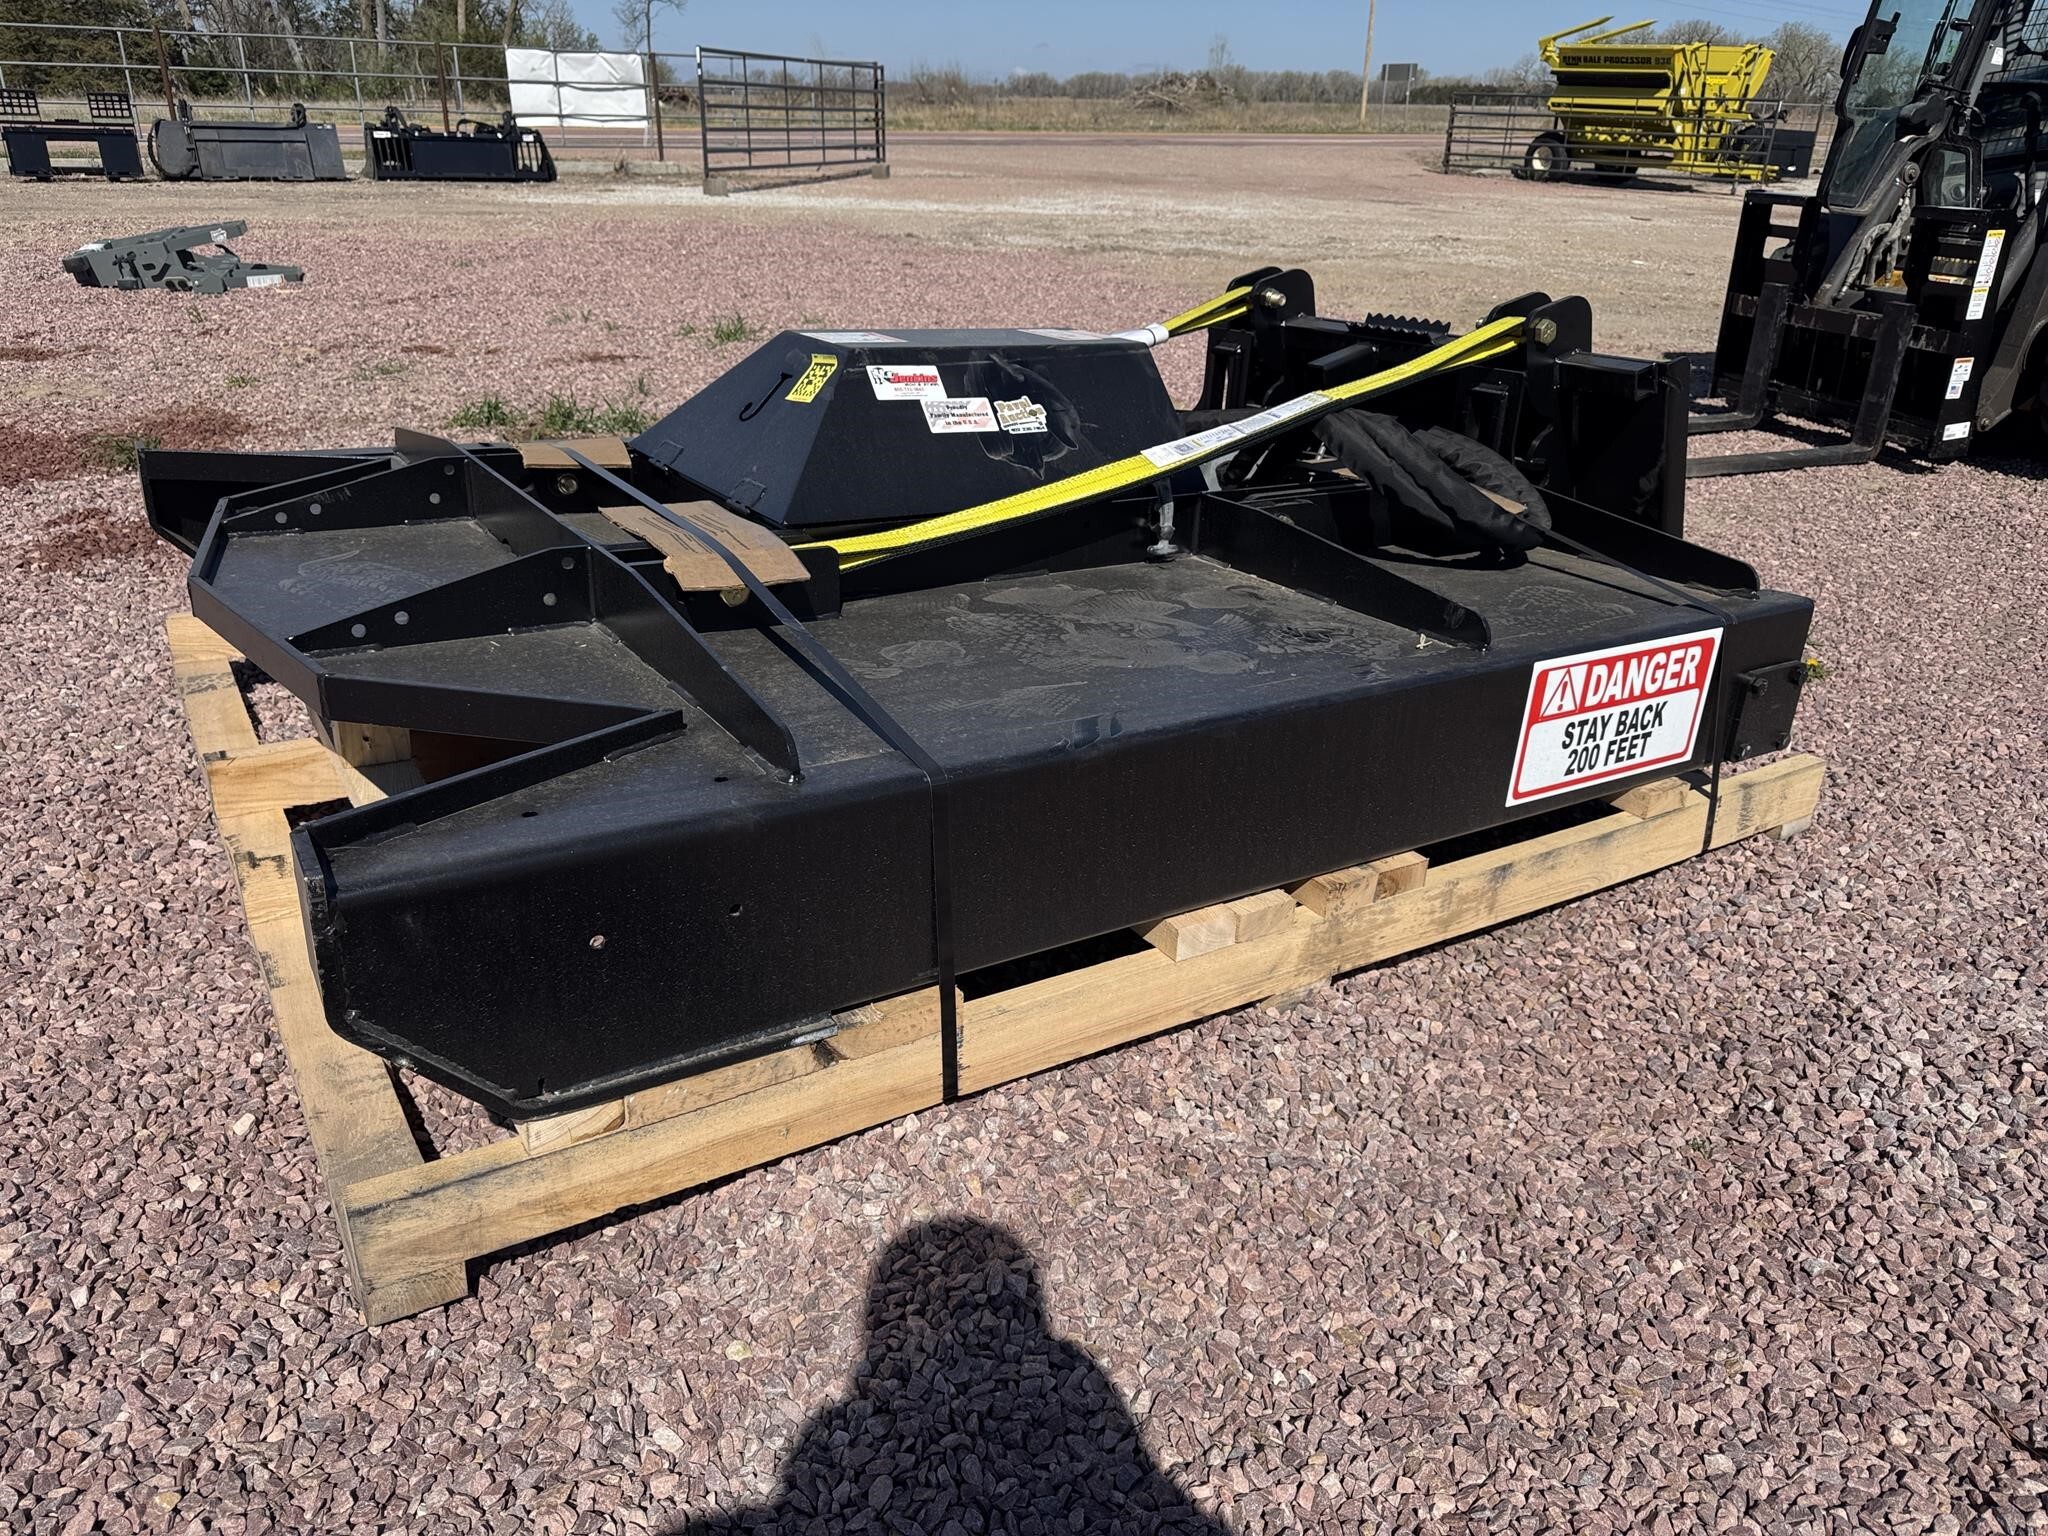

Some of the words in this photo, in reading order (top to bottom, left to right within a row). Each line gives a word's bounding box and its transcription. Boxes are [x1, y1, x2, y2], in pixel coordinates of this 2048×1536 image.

[1583, 55, 1601, 64] BALE
[1603, 56, 1652, 64] PROCESSOR
[1584, 645, 1703, 708] DANGER
[1561, 713, 1613, 750] STAY
[1614, 701, 1668, 737] BACK
[1564, 744, 1600, 777] 200
[1603, 731, 1653, 767] FEET
